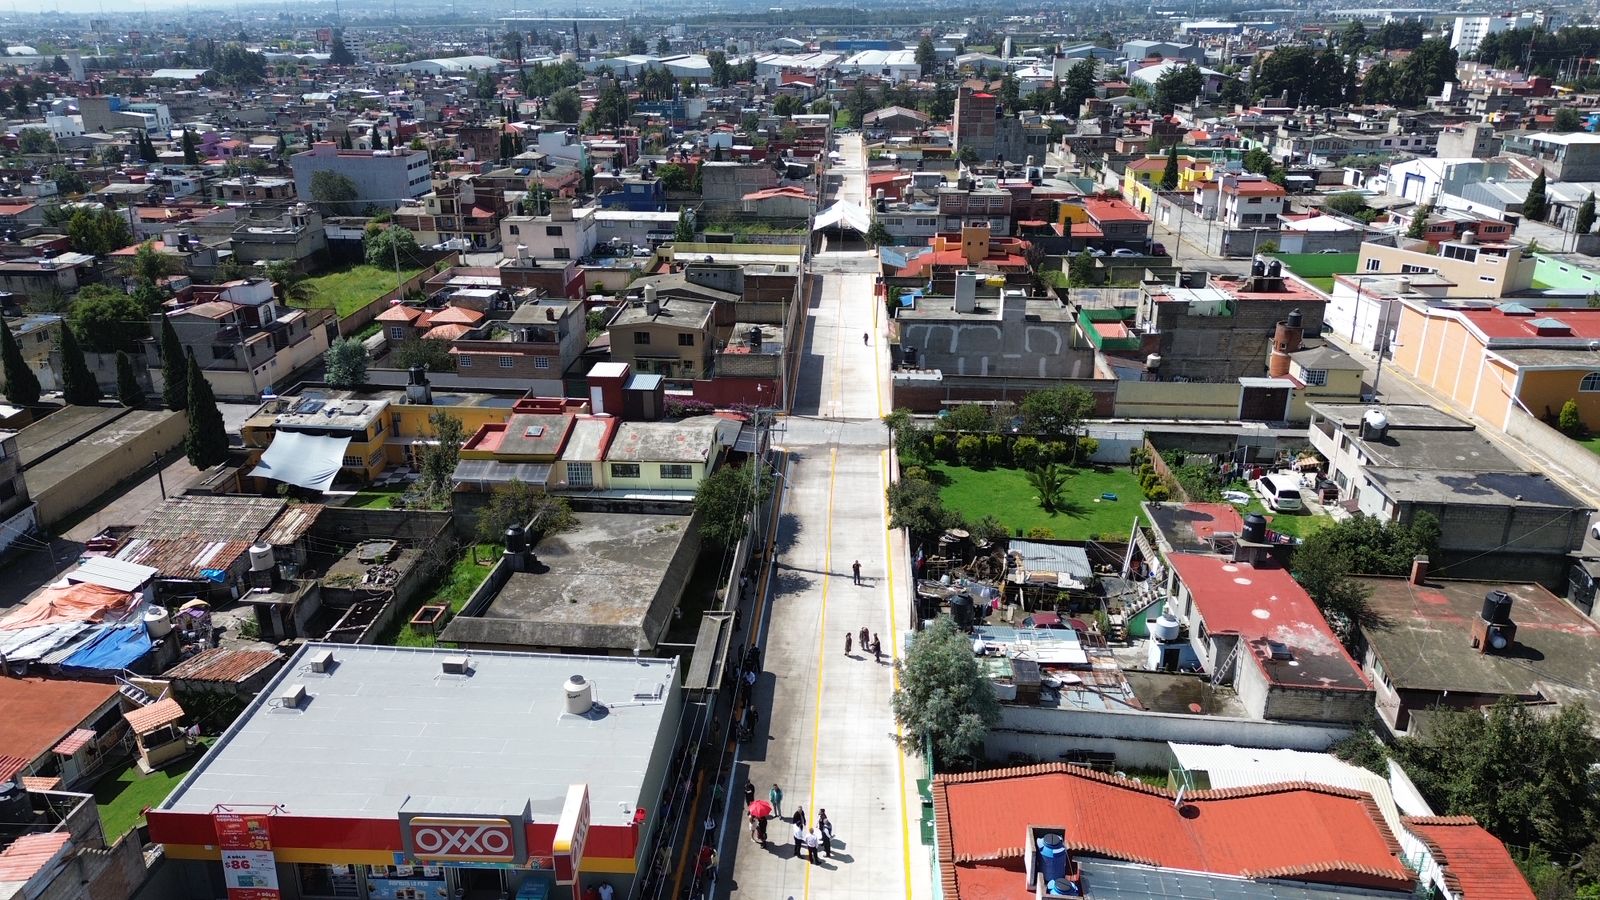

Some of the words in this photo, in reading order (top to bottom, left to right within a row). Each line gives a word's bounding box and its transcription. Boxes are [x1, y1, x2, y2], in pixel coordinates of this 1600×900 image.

[249, 840, 271, 850] $91
[415, 826, 509, 855] OXXO
[225, 860, 250, 869] $86
